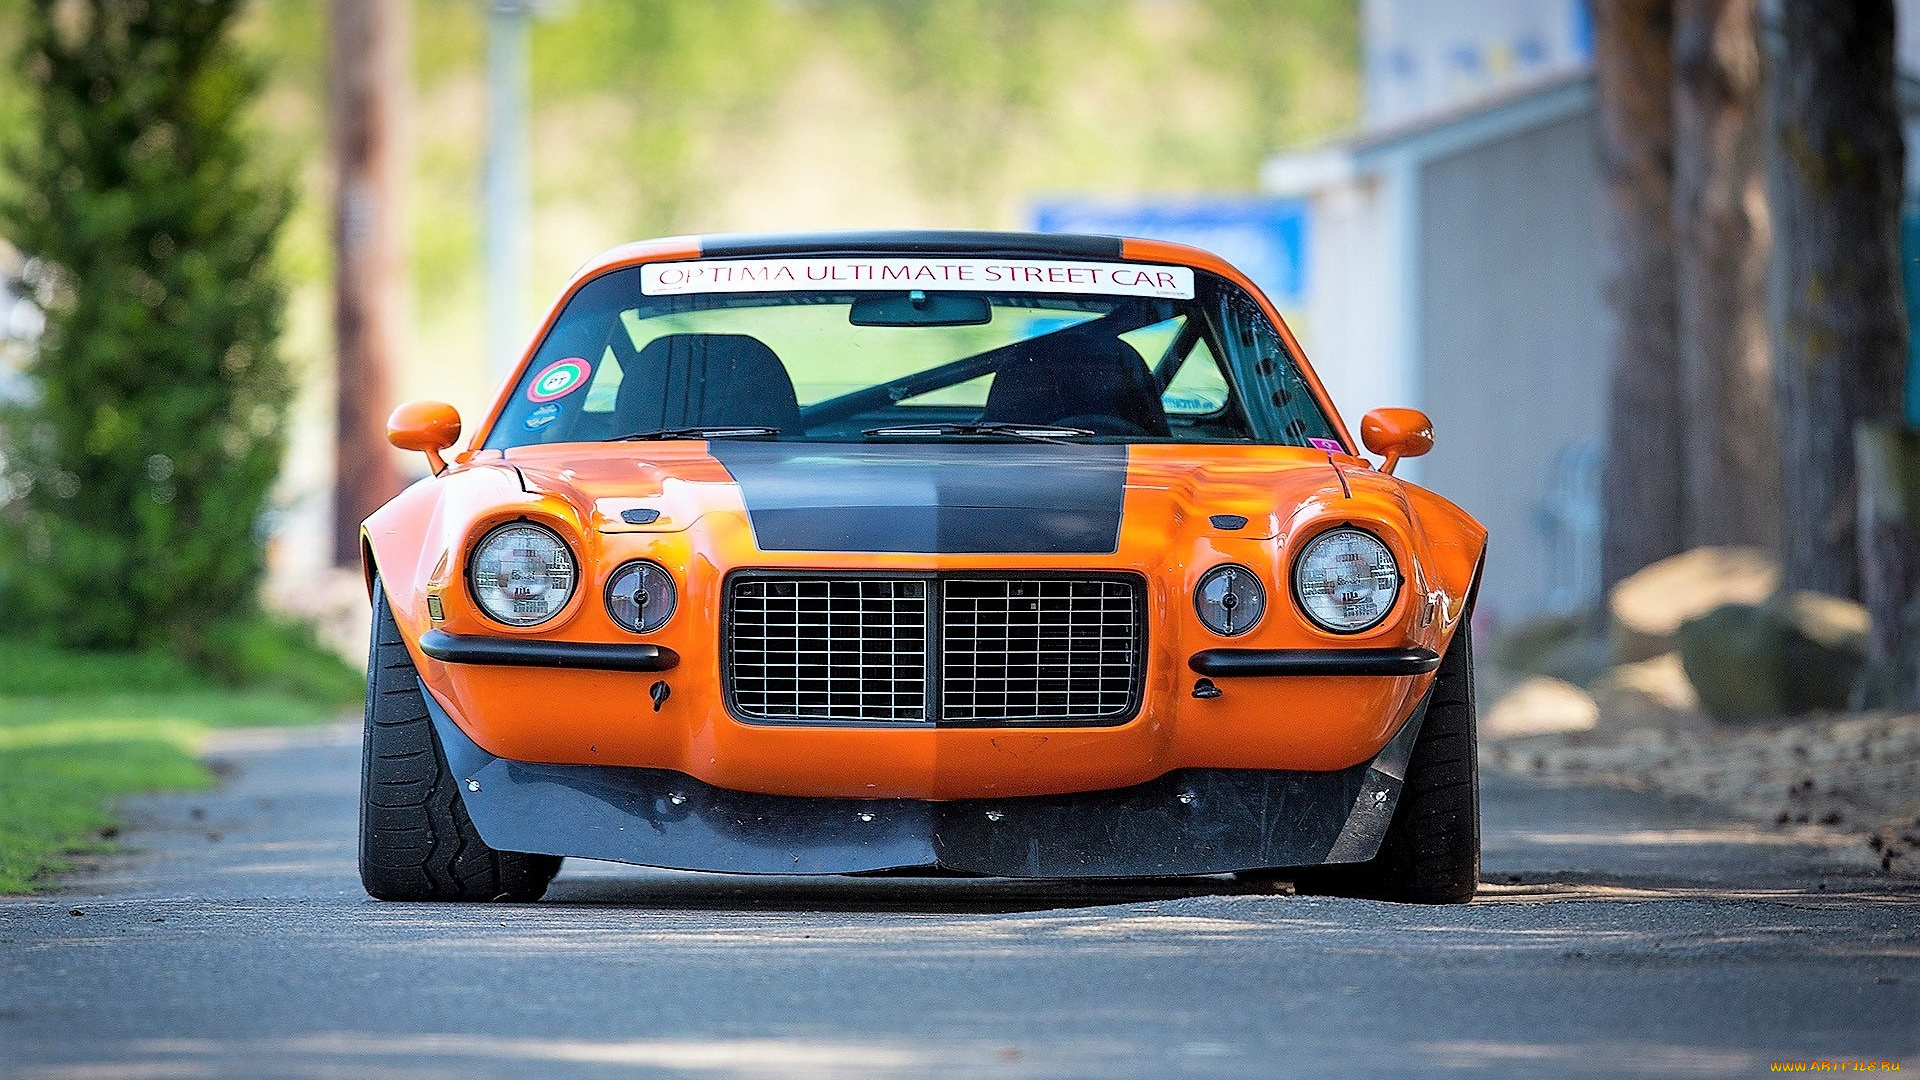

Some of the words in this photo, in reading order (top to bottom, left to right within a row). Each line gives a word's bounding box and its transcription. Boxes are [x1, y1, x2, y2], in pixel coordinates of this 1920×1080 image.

[659, 265, 795, 285] OPTIMA
[806, 264, 975, 281] ULTIMATE
[984, 265, 1104, 284] STREET
[1111, 269, 1177, 289] CAR
